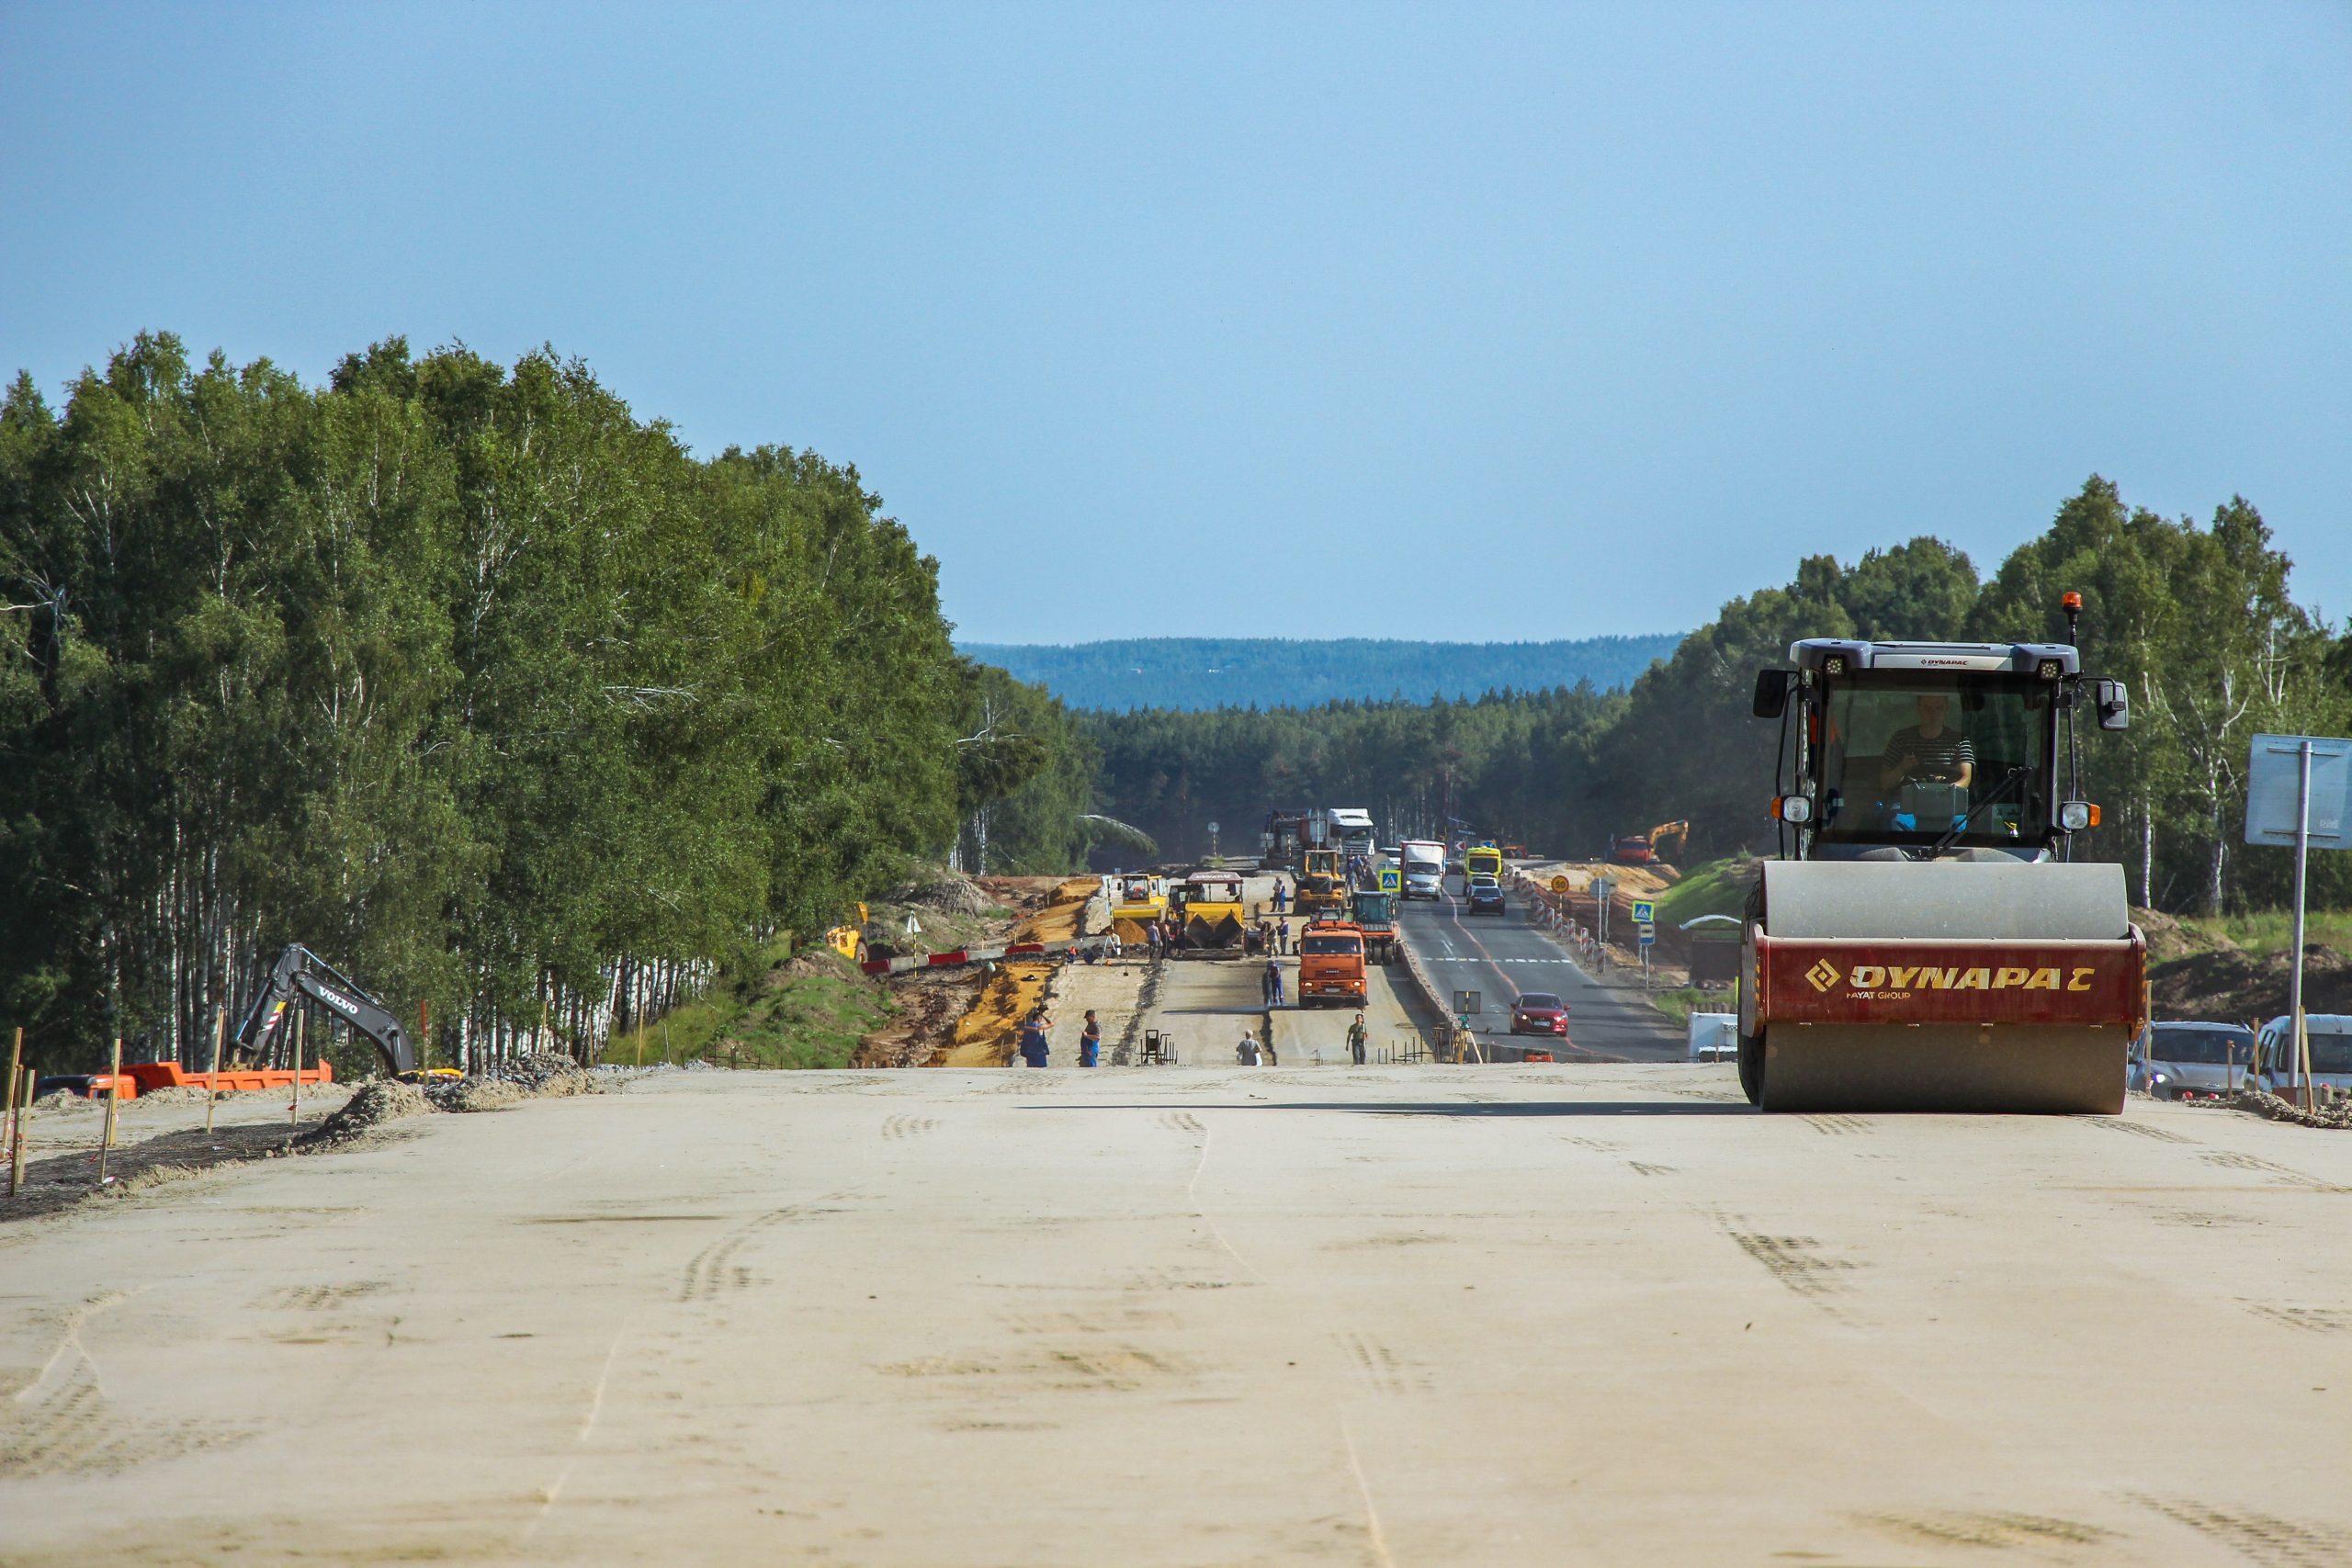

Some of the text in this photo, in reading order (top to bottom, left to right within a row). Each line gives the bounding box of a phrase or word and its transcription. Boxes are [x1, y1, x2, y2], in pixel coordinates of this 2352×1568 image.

[1555, 881, 1566, 889] 50
[1849, 965, 2096, 991] DYNAPAC
[318, 985, 358, 1015] VOLVO
[1877, 991, 1911, 999] GROUP
